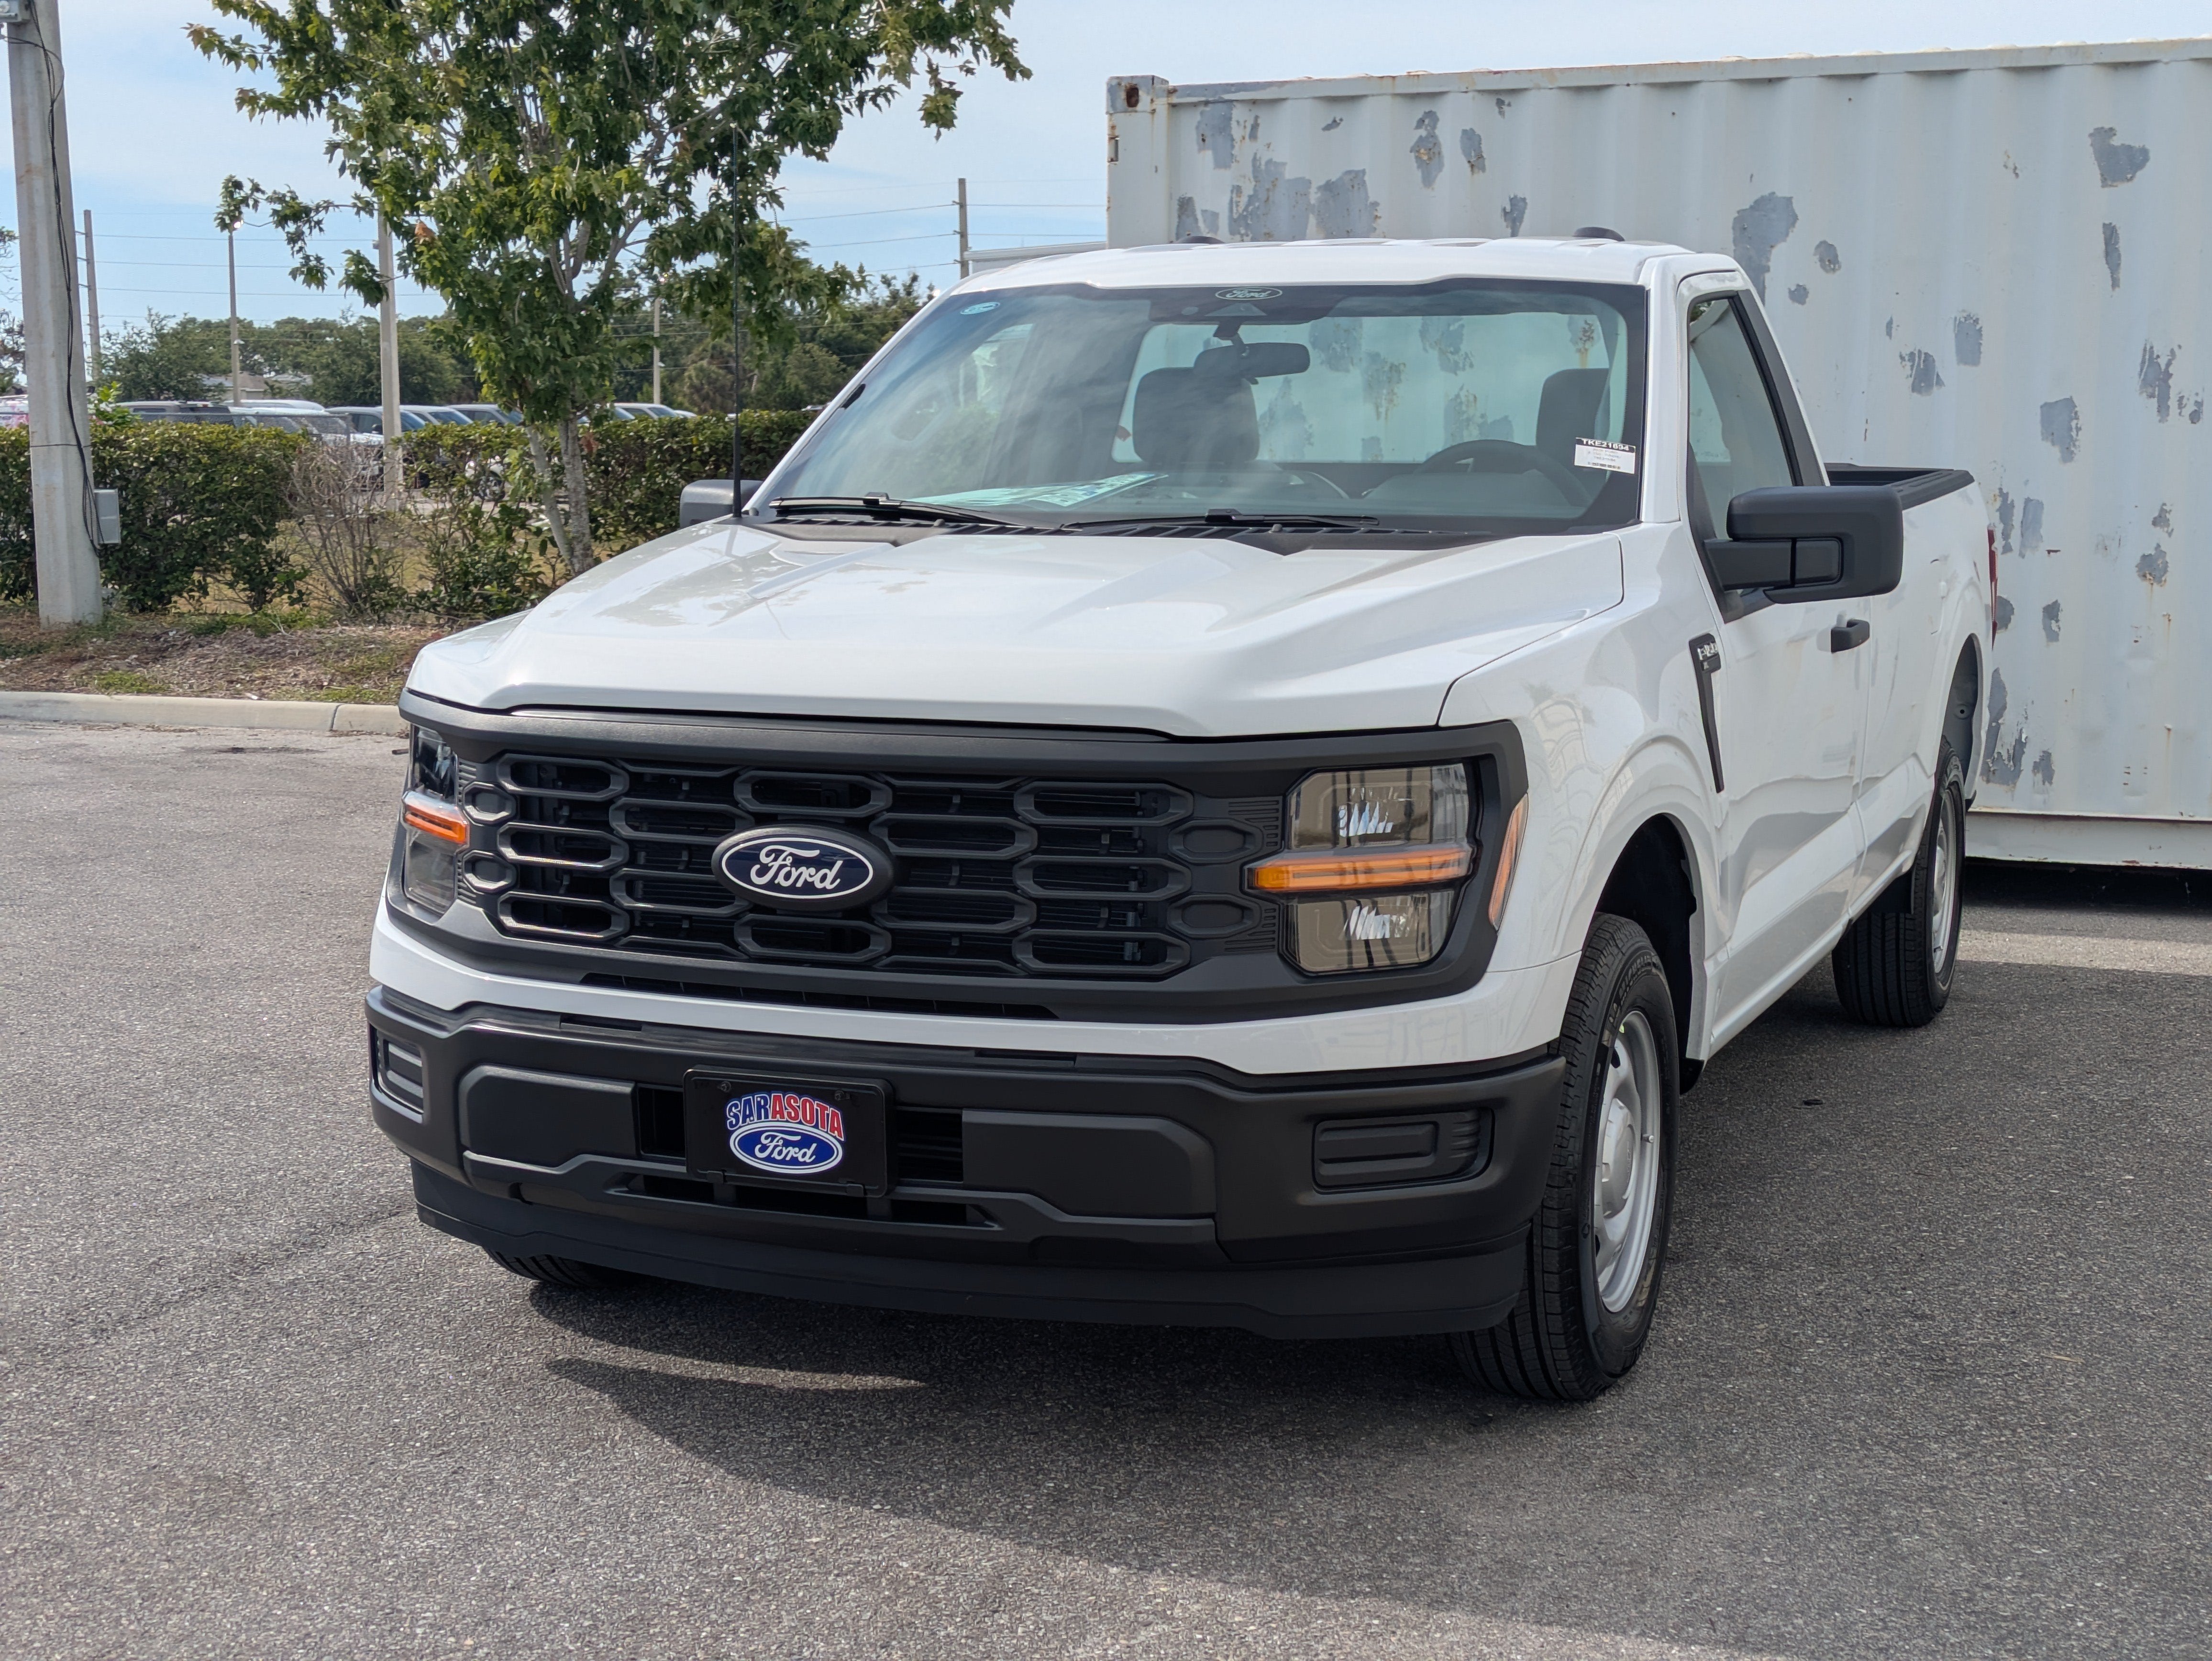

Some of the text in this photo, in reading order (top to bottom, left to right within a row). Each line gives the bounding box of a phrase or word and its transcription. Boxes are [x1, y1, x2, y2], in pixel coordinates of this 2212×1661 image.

[1225, 288, 1271, 298] Ford
[750, 845, 843, 890] Ford
[726, 1093, 846, 1141] SARASOTA
[754, 1131, 816, 1163] Ford
